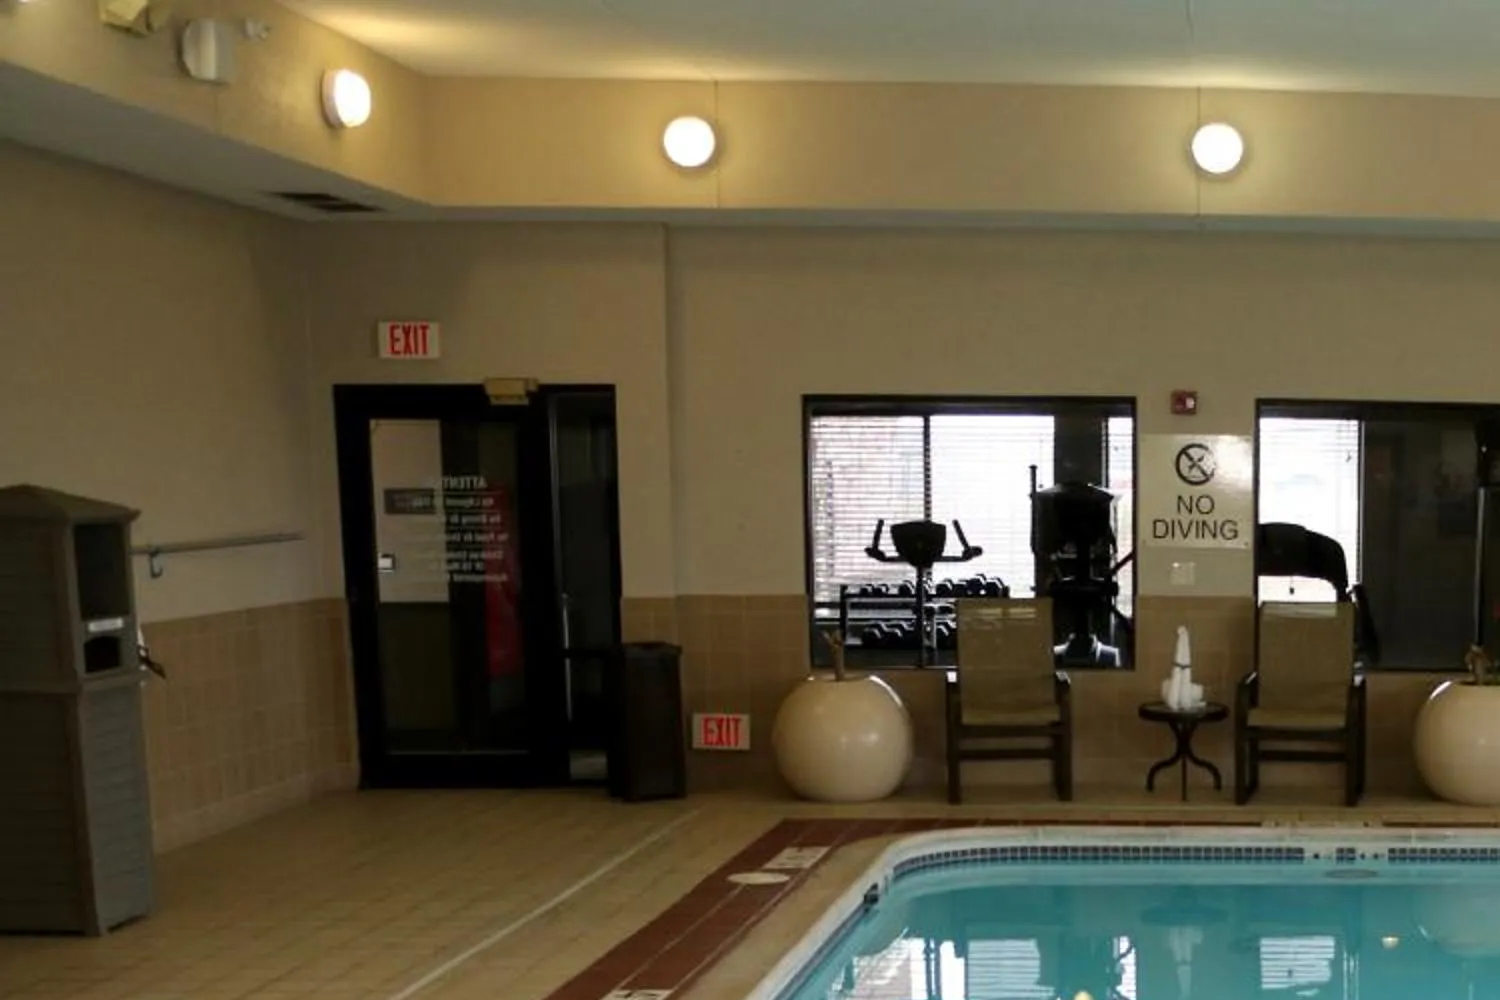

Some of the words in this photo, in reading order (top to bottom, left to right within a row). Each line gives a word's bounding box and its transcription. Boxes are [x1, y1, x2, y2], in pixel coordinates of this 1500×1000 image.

[389, 322, 430, 355] EXIT
[1177, 495, 1215, 515] NO
[1153, 520, 1238, 540] DIVING
[703, 716, 743, 747] EXIT
